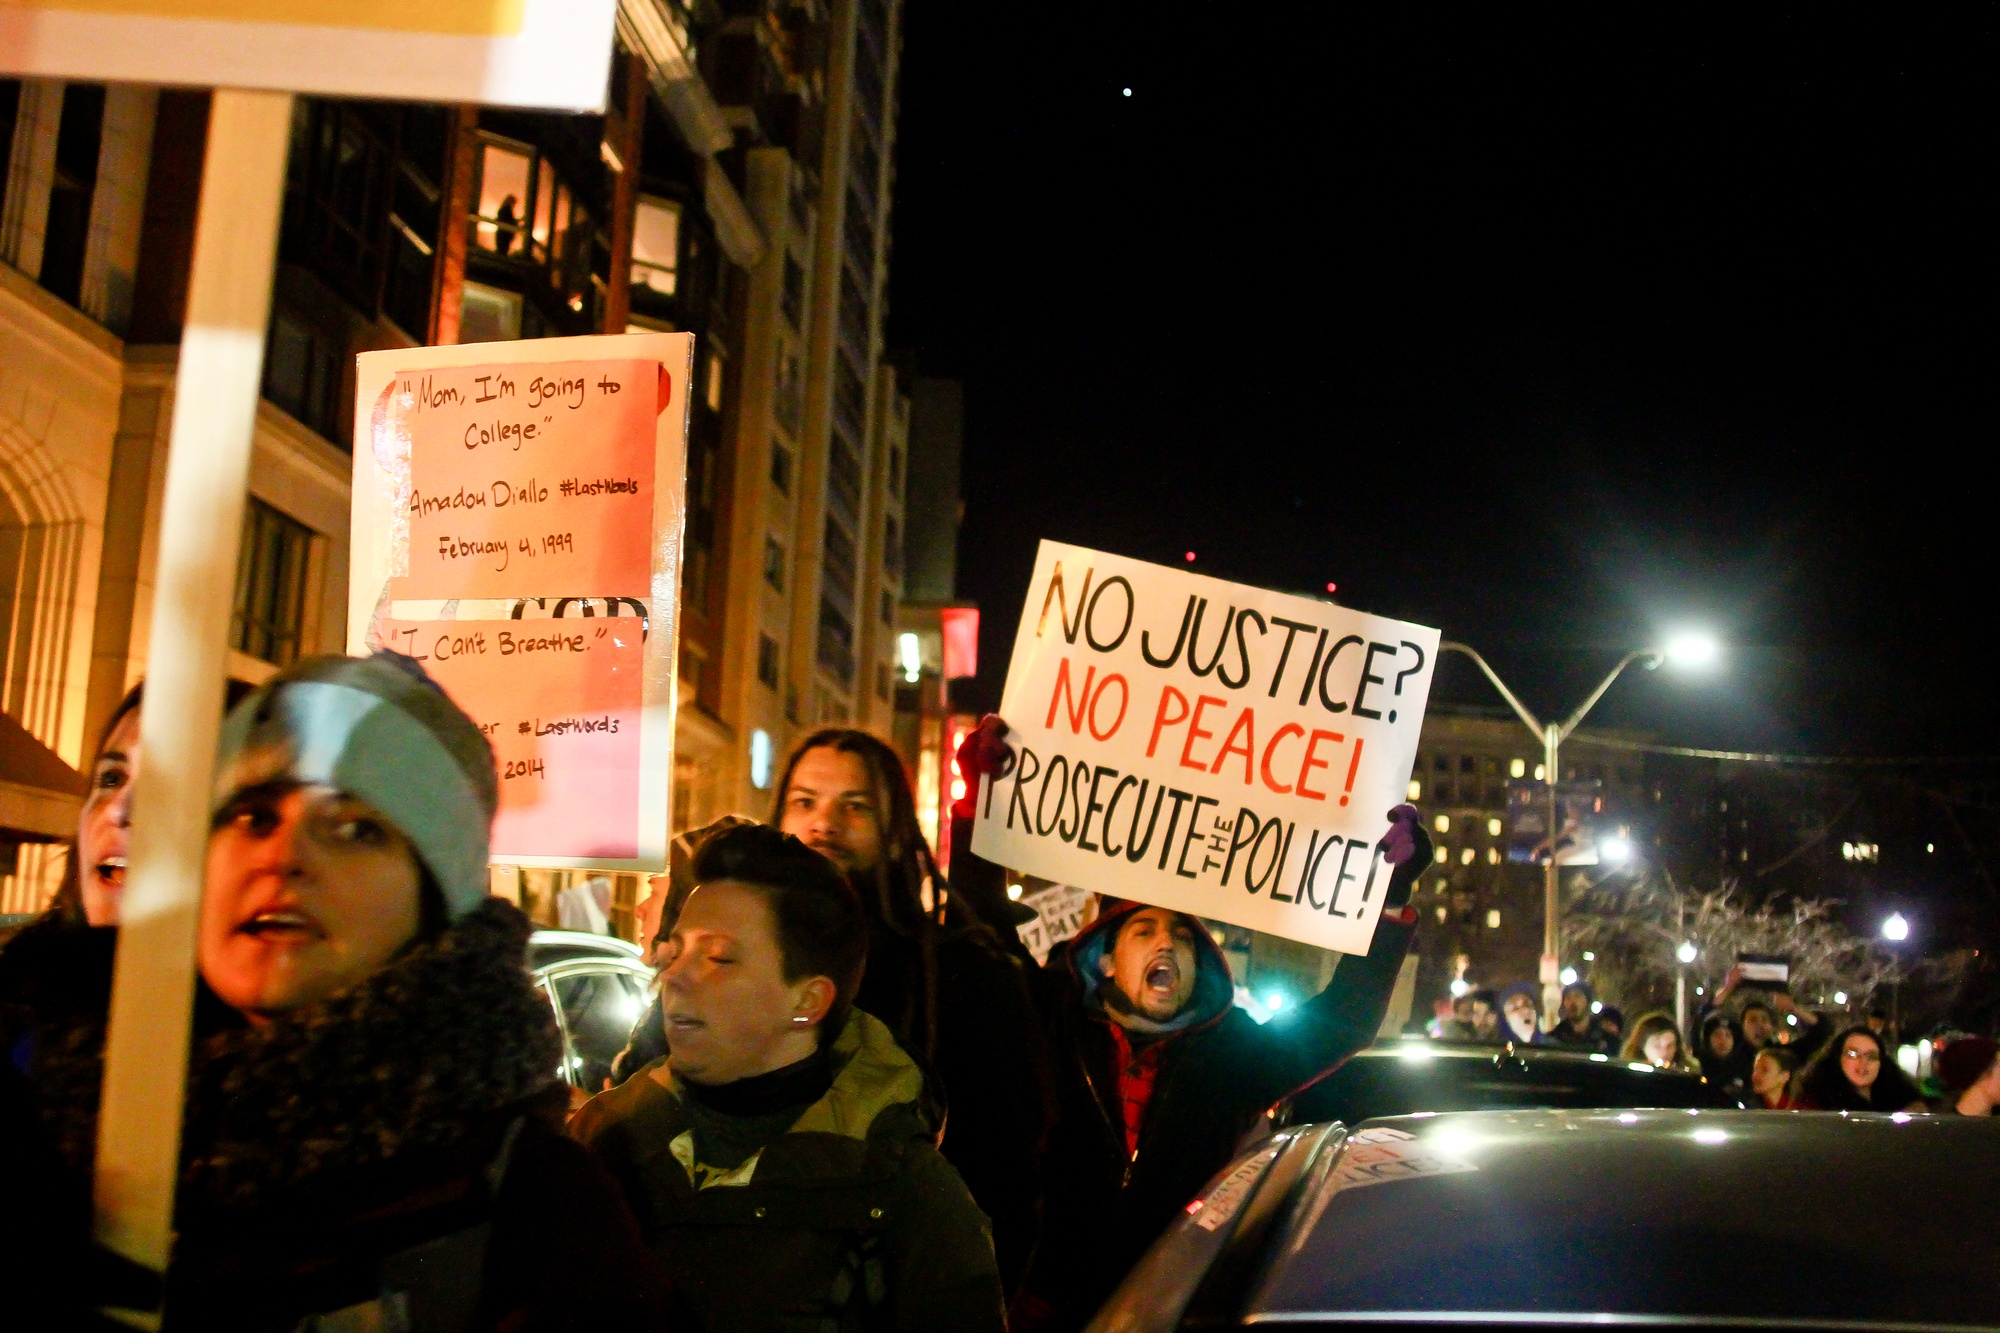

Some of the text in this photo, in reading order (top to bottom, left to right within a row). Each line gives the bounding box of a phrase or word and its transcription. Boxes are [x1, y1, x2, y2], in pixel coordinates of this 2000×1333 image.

[475, 373, 515, 403] I'm
[528, 376, 585, 409] going
[597, 374, 621, 395] to
[410, 484, 486, 518] Amadou
[491, 478, 548, 507] Diallo
[439, 536, 509, 571] February
[543, 533, 573, 554] 1999
[434, 631, 487, 660] Can't
[1036, 560, 1425, 723] NO JUSTICE?
[518, 715, 620, 737] #LastWords
[1045, 657, 1364, 807] NO PEACE!
[504, 758, 545, 780] 2014
[1201, 815, 1234, 873] THE
[1221, 807, 1383, 920] POLICE!
